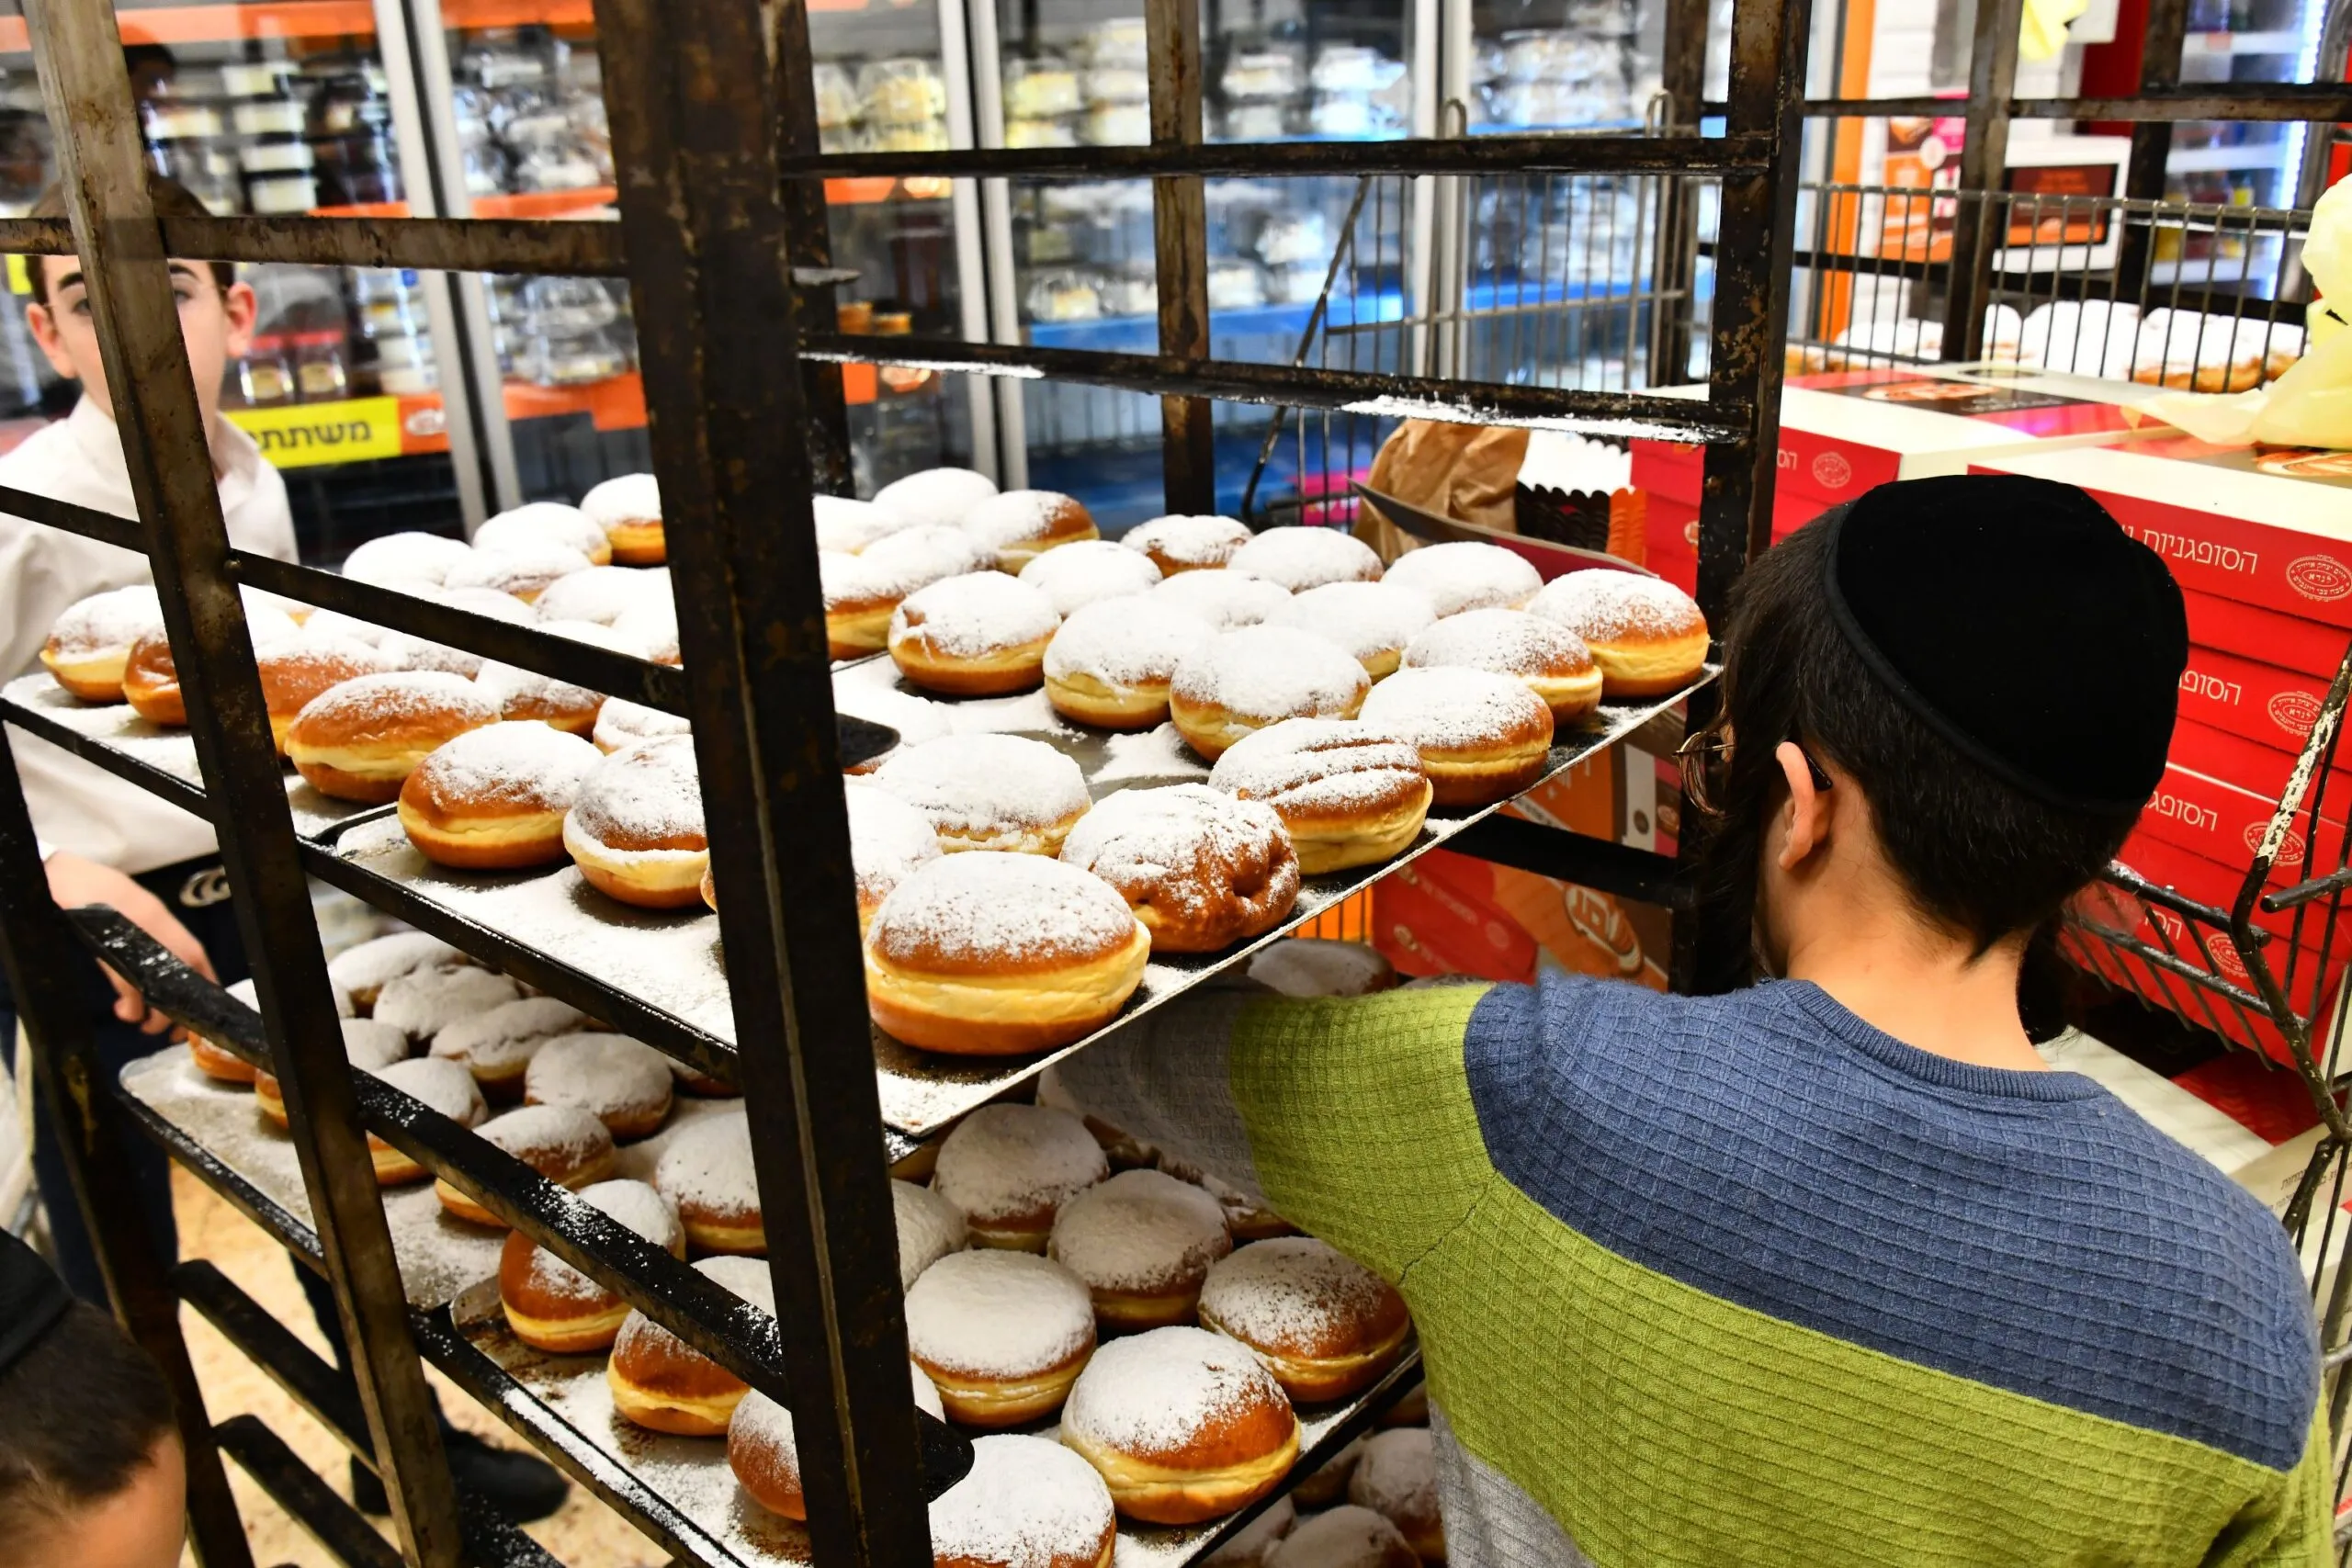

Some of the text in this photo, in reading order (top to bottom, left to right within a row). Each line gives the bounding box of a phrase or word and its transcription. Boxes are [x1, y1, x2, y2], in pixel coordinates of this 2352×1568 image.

[2143, 529, 2258, 574] הסופגניות
[2178, 670, 2242, 705] הסופ
[2145, 790, 2219, 831] הסופג
